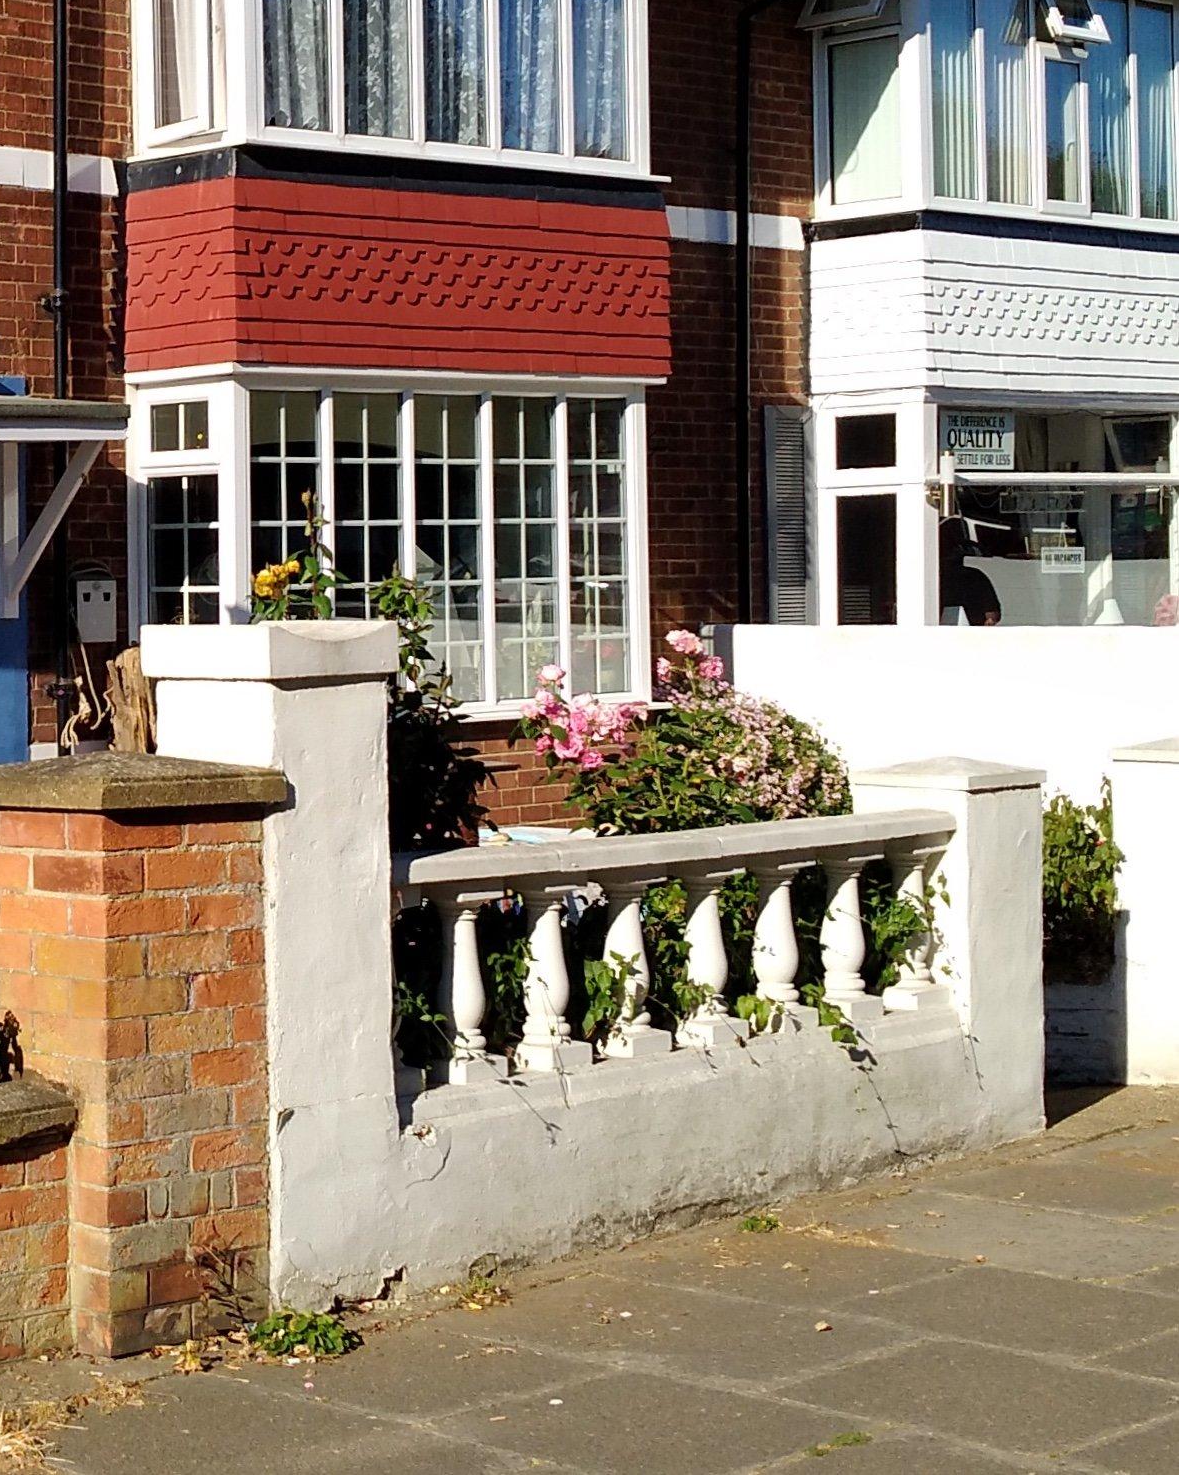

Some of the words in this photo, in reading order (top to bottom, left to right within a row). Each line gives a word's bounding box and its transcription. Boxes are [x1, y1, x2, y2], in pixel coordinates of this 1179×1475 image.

[947, 415, 959, 426] THE
[960, 415, 997, 427] DIFFERENCE
[998, 416, 1005, 428] IS
[947, 428, 1005, 449] QUALITY
[957, 453, 979, 465] SETTLE
[980, 454, 994, 465] FOR
[995, 454, 1011, 465] LESS
